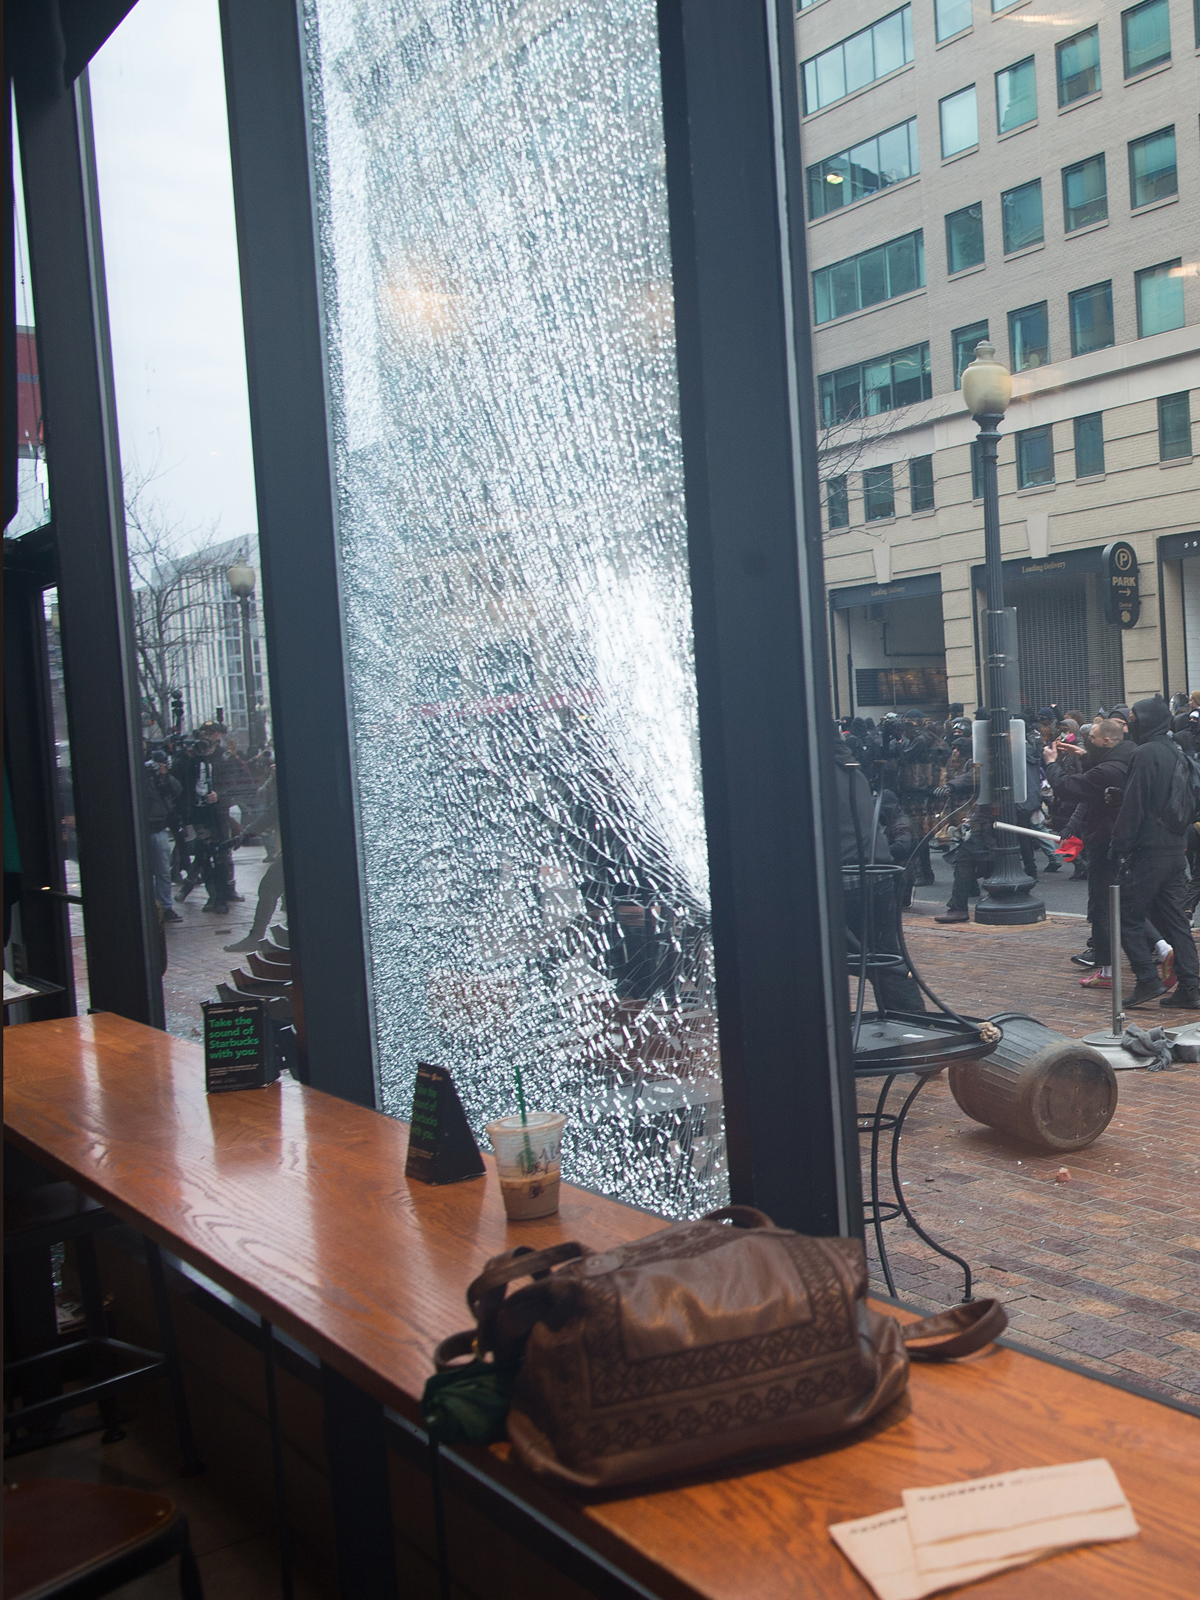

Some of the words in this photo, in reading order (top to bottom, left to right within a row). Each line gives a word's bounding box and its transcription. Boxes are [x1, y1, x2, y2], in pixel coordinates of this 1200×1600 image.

[1112, 576, 1137, 587] PARK
[208, 1018, 233, 1028] Take
[235, 1016, 252, 1025] the
[209, 1027, 240, 1039] sound
[242, 1025, 254, 1036] of
[209, 1036, 260, 1049] Starbucks
[209, 1048, 234, 1059] with
[235, 1048, 258, 1059] you.
